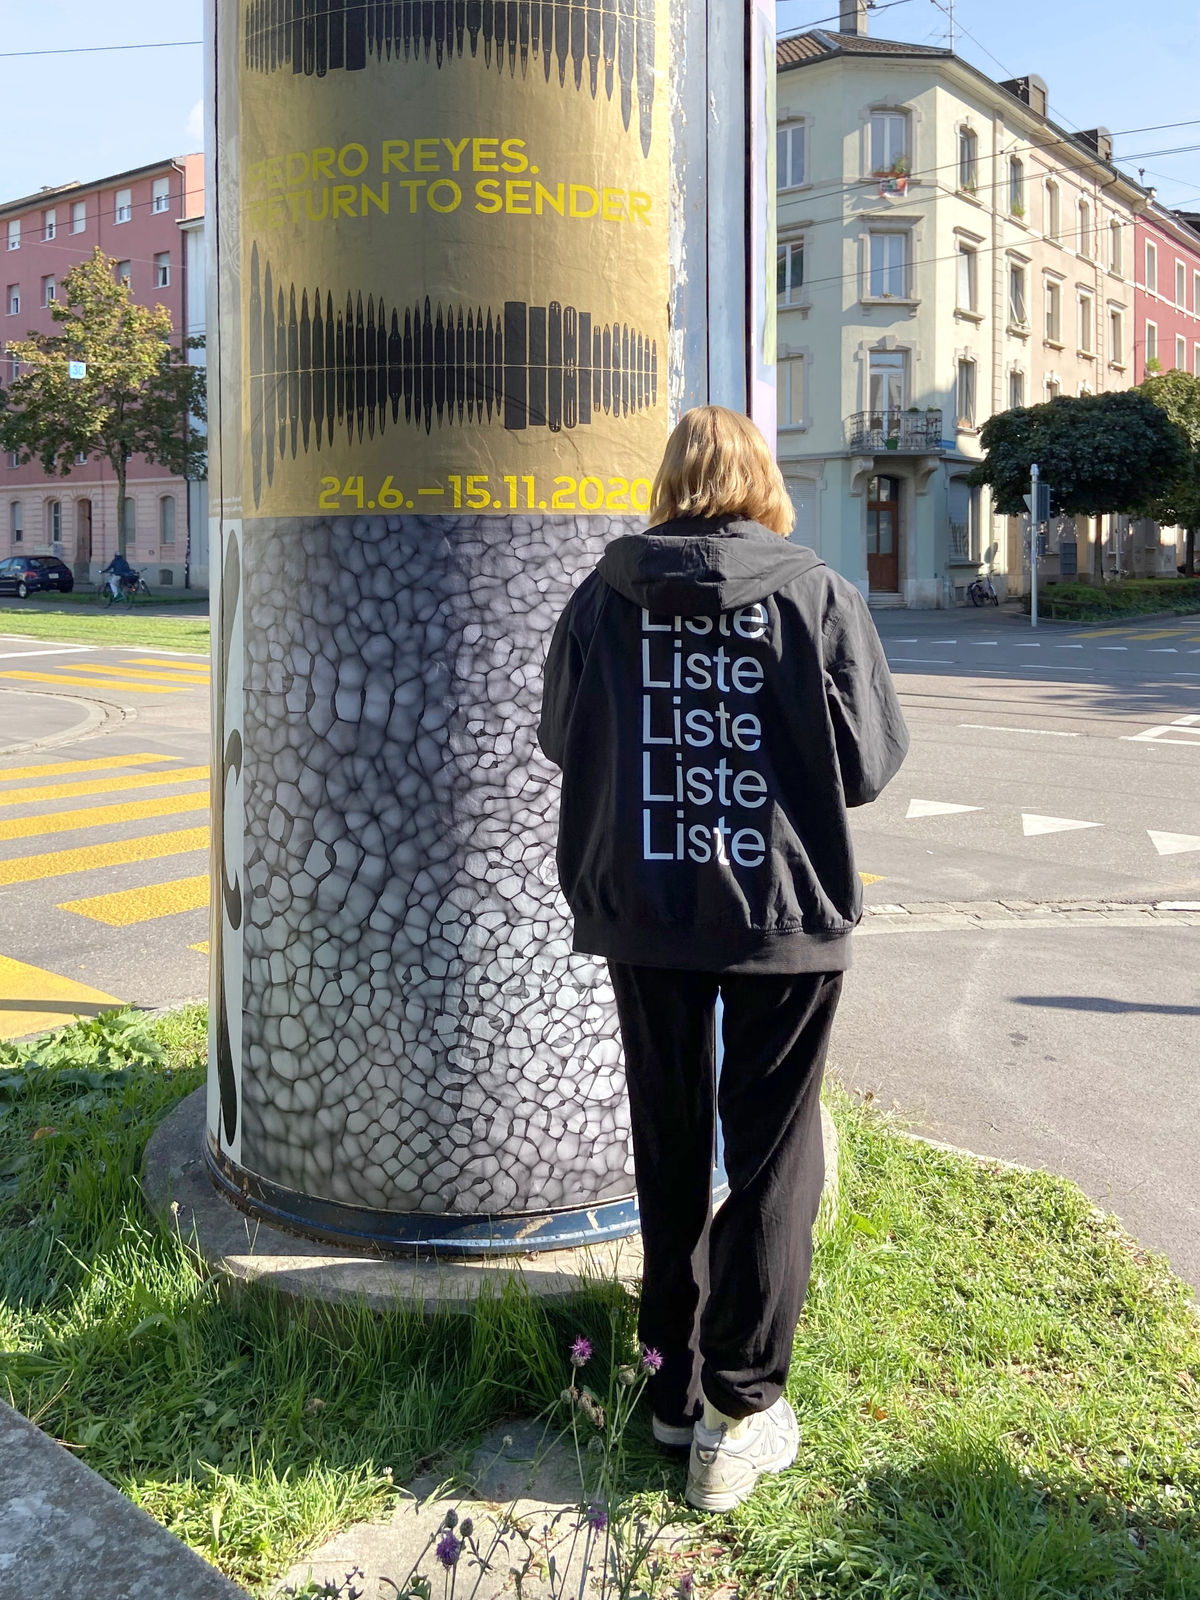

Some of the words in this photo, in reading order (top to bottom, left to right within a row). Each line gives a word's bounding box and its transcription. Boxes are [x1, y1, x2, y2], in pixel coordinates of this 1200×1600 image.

[249, 143, 369, 193] PEDRO
[382, 138, 540, 174] REYES.
[249, 182, 389, 231] RETURN
[400, 178, 462, 213] TO
[475, 178, 653, 226] SENDER
[642, 638, 764, 694] Liste
[642, 695, 762, 751] Liste
[643, 751, 768, 808] Liste
[643, 809, 766, 867] Liste
